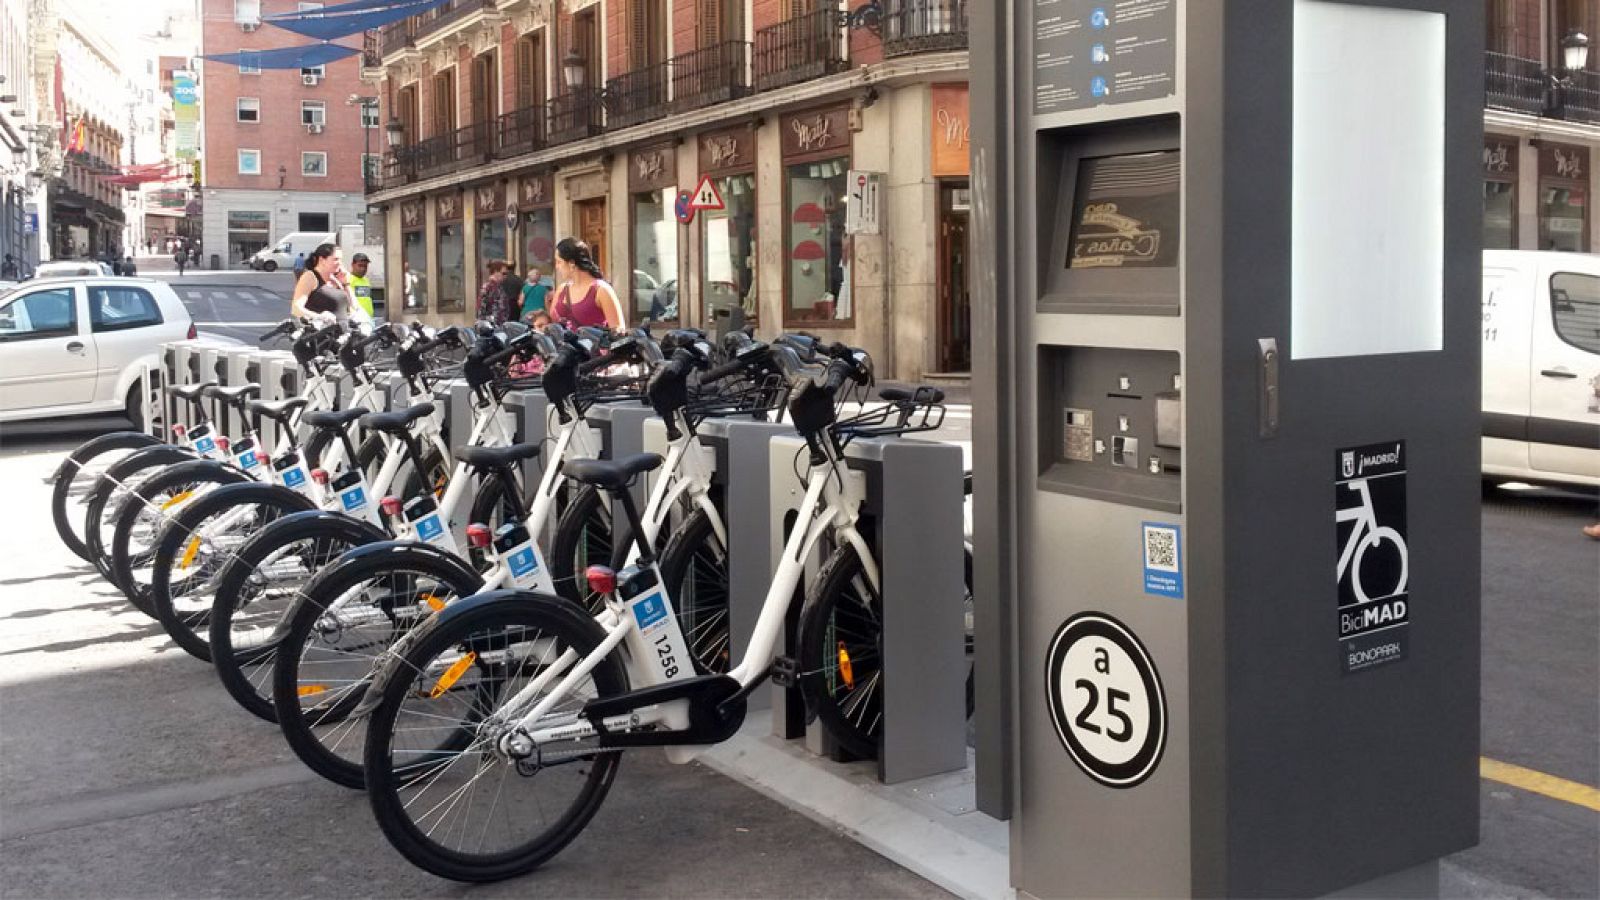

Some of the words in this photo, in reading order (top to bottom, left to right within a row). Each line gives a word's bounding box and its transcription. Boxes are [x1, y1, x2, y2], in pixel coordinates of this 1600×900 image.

[792, 114, 835, 148] Maty
[1342, 601, 1406, 633] BiciMAD
[654, 634, 679, 679] 1258
[1094, 647, 1110, 675] a
[1075, 678, 1133, 743] 25
